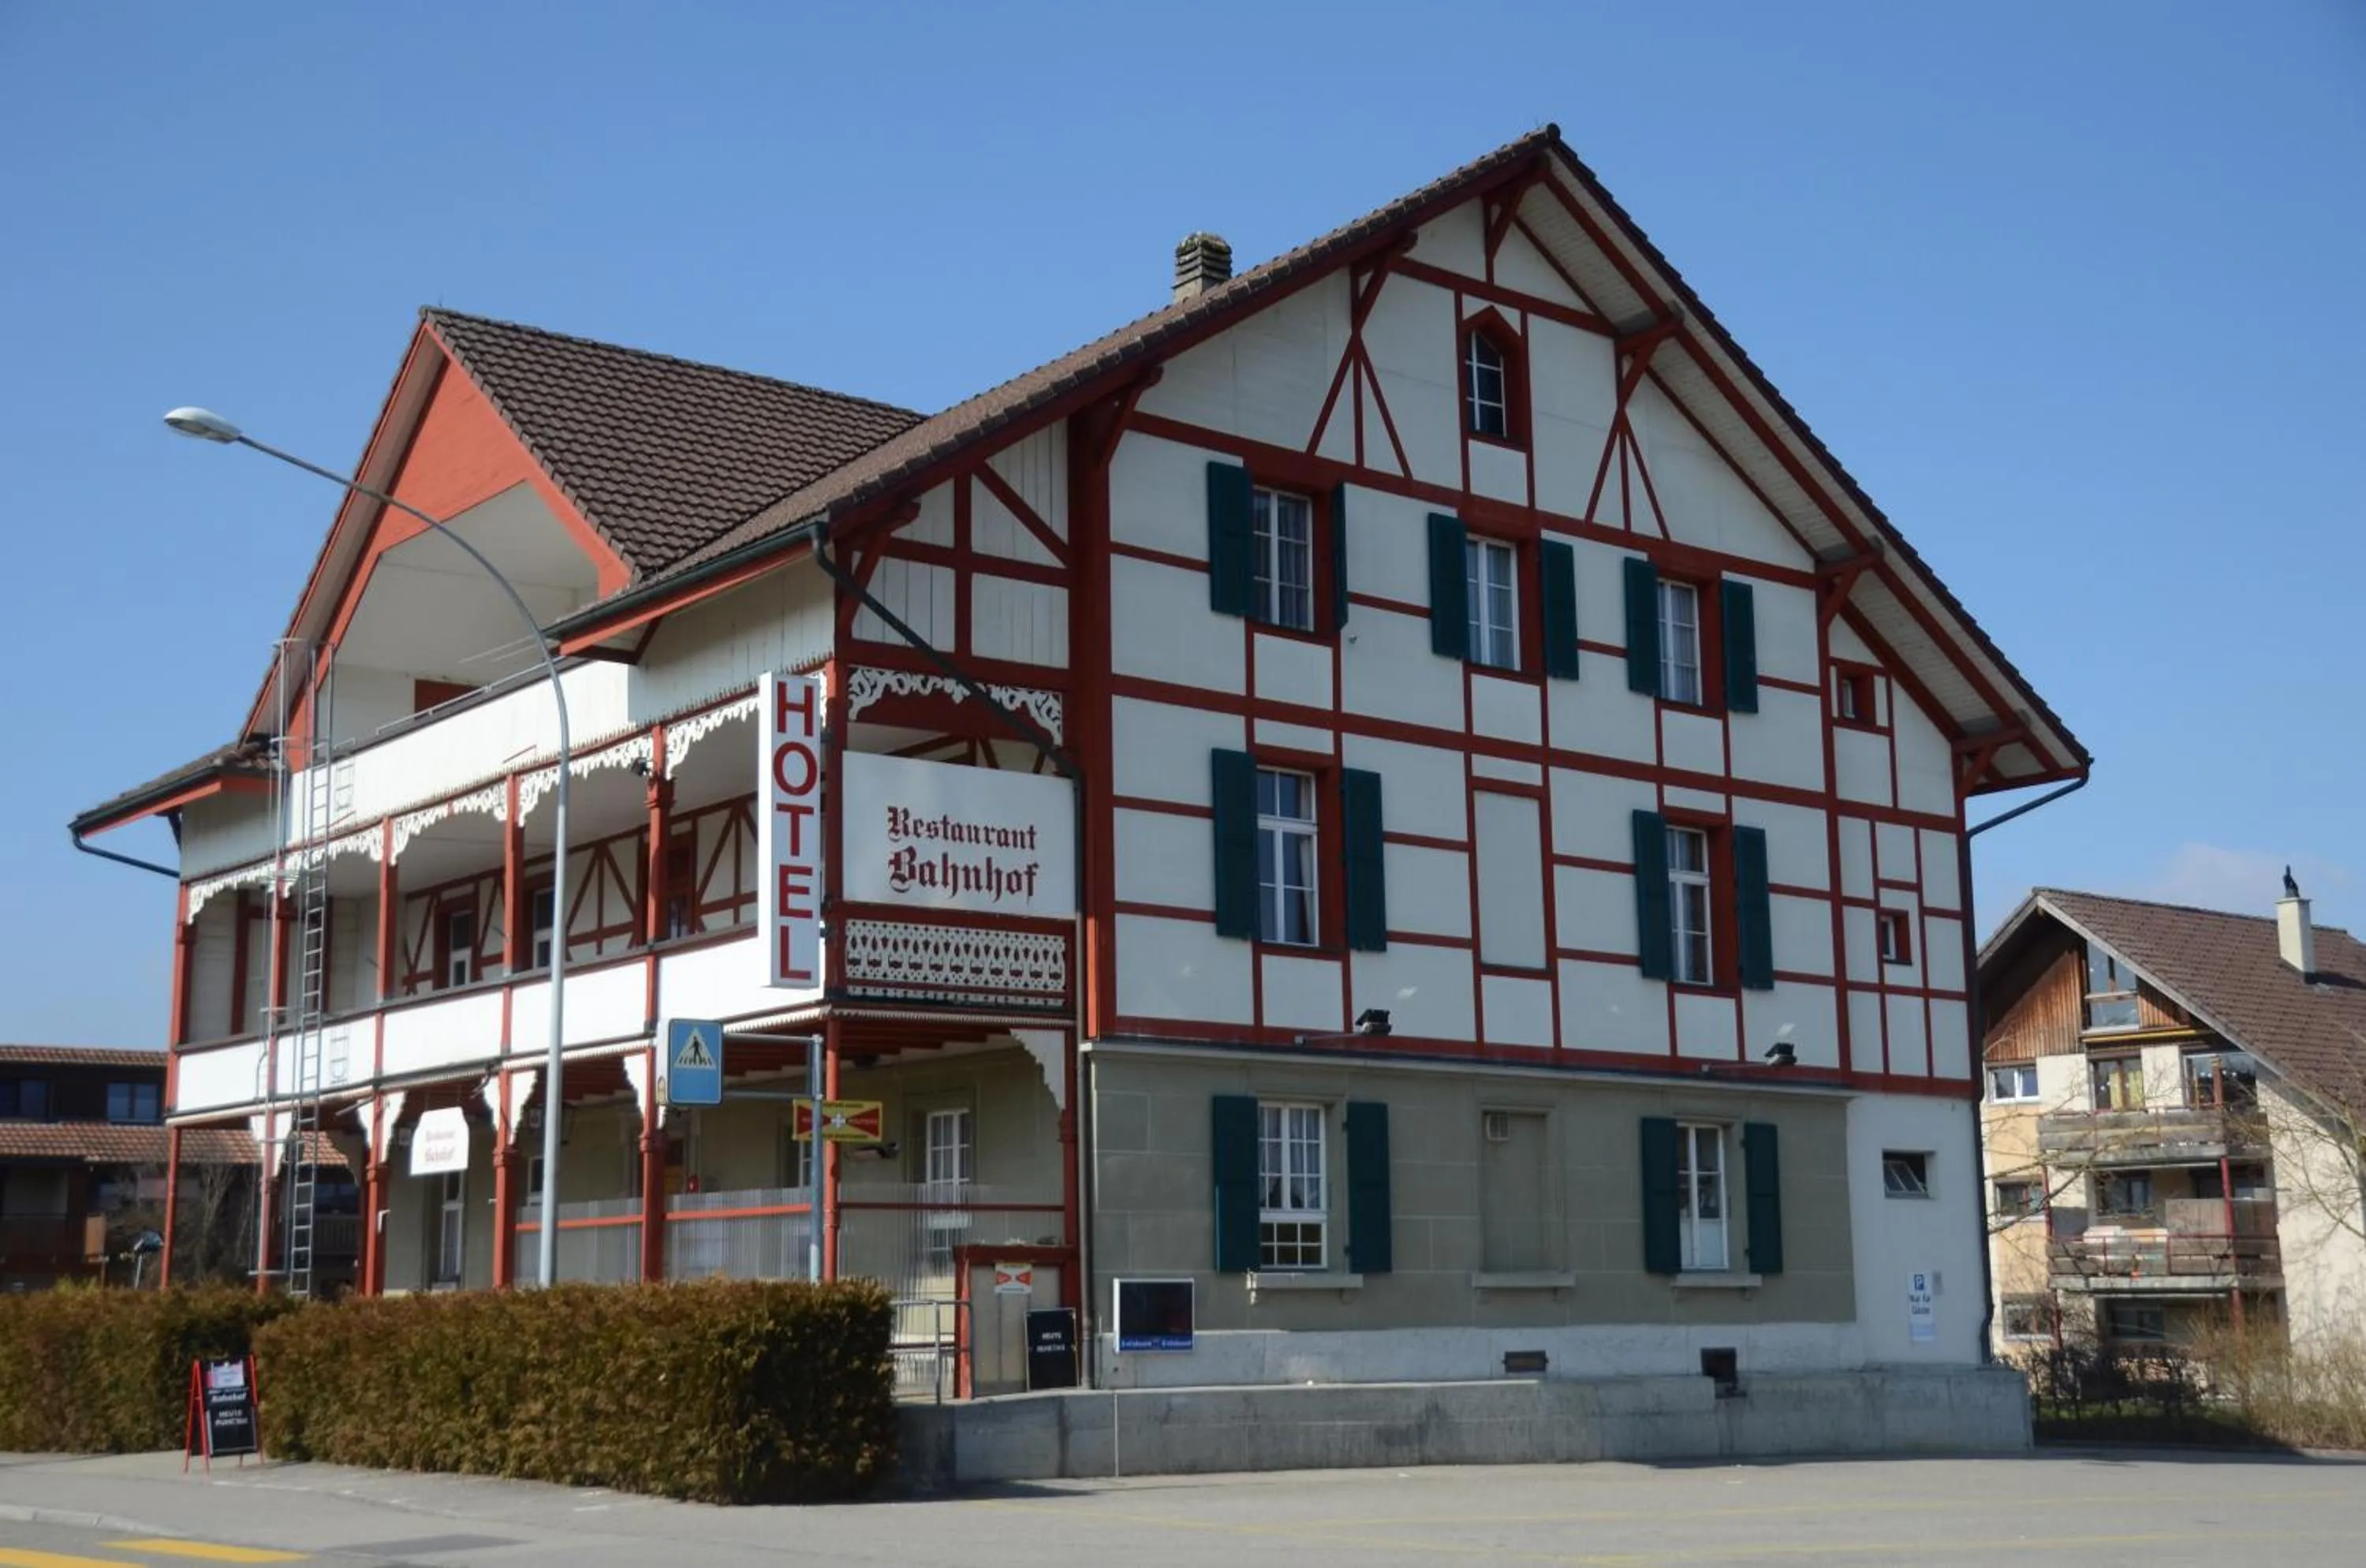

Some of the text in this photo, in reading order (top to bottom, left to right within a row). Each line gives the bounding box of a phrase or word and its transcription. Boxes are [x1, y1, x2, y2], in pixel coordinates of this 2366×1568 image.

[773, 681, 817, 980] HOTEL
[887, 805, 1036, 850] Restaurant
[888, 846, 1039, 905] Bahnhof
